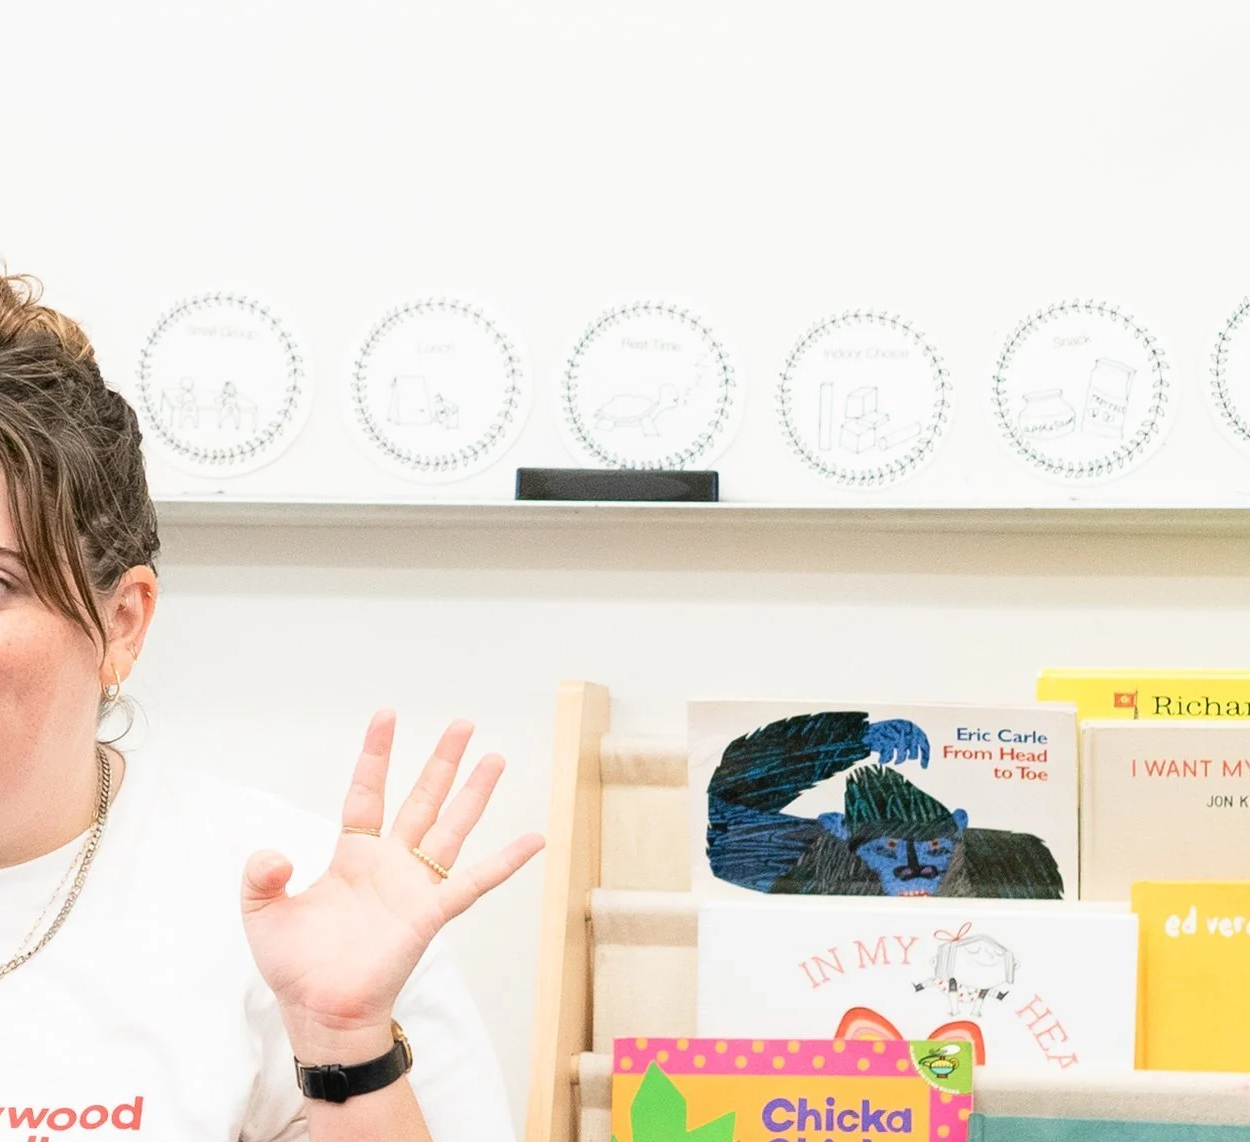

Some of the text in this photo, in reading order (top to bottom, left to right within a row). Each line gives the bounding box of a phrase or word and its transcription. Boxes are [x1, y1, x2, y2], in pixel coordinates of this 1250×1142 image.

[956, 727, 1048, 745] Eric Carle
[943, 745, 1048, 763] From Head
[994, 765, 1048, 780] to Toe
[1131, 759, 1137, 778] I
[1145, 759, 1212, 778] WANT
[1206, 795, 1233, 808] JON
[1165, 905, 1197, 938] ed
[798, 947, 844, 988] IN
[853, 935, 919, 968] MY
[762, 1097, 912, 1133] Chicka
